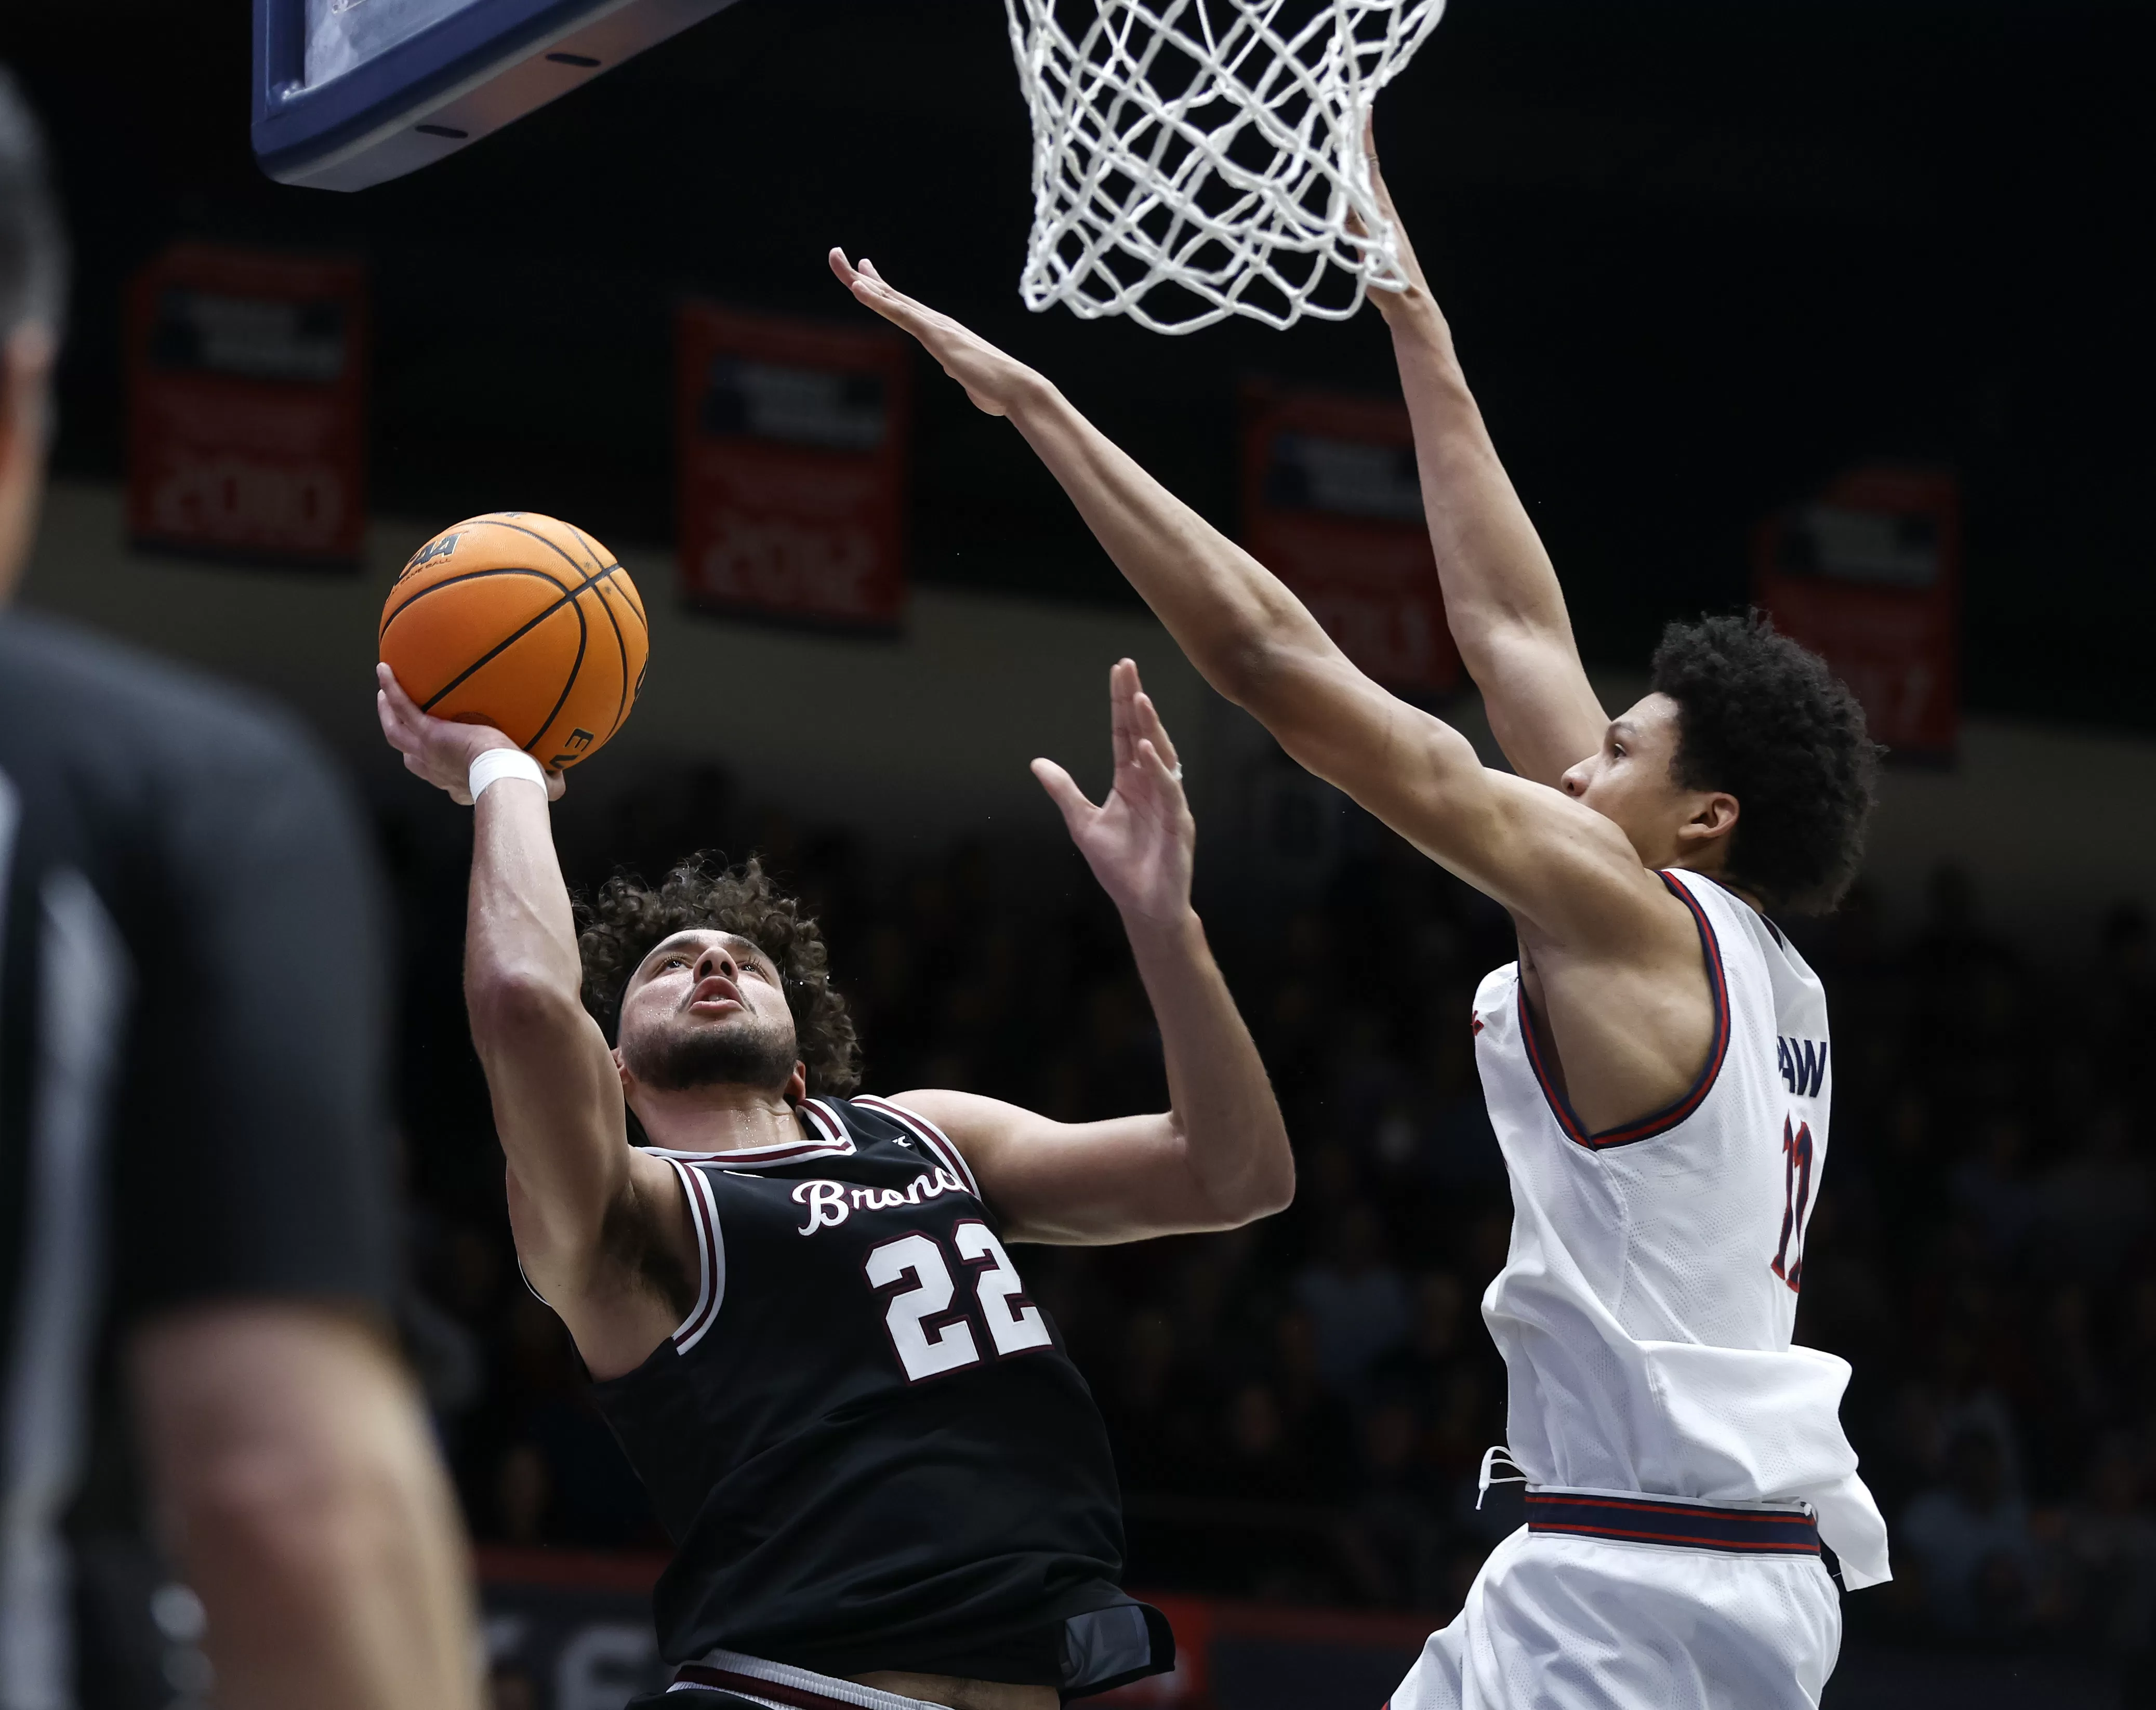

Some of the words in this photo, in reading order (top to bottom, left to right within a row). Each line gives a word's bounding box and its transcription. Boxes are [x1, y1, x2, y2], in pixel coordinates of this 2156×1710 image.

[1777, 1036, 1827, 1097] AW
[1770, 1108, 1813, 1293] 11
[859, 1219, 1054, 1386] 22
